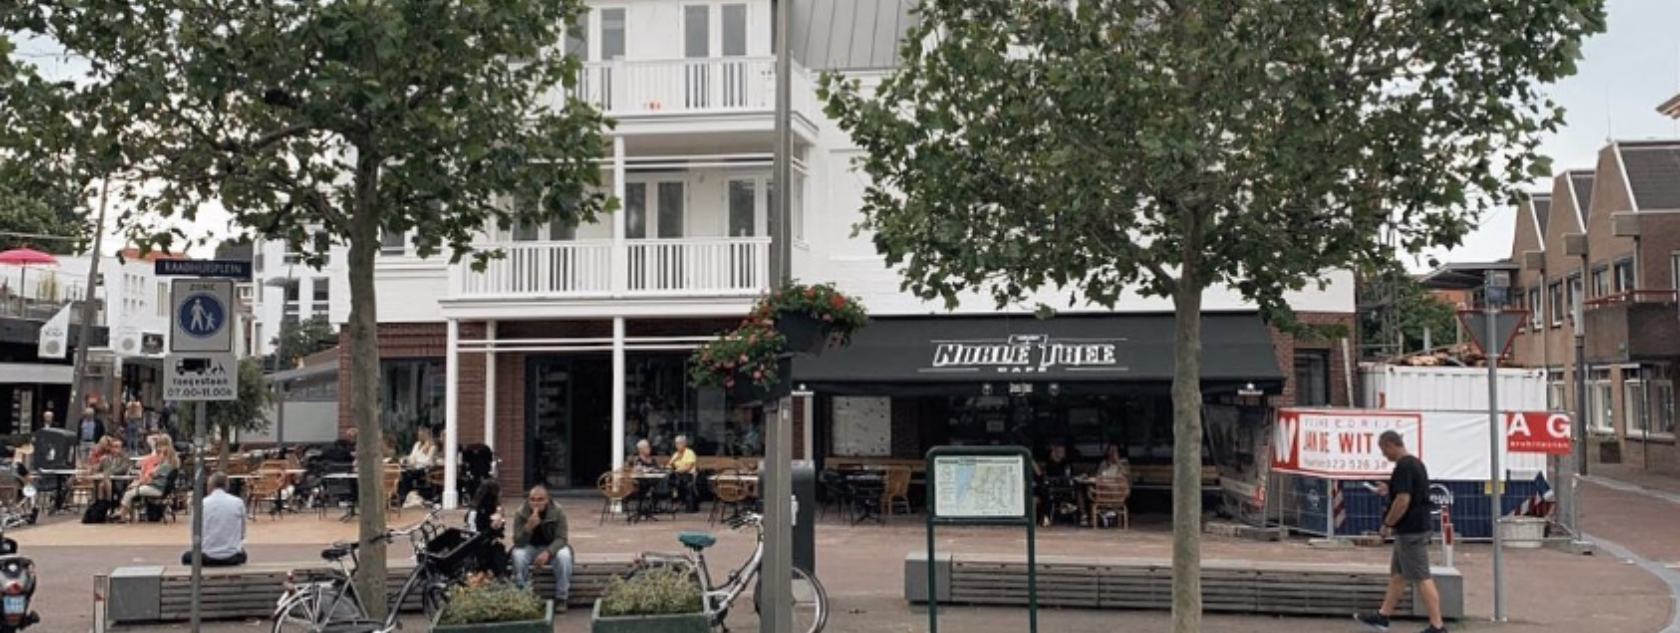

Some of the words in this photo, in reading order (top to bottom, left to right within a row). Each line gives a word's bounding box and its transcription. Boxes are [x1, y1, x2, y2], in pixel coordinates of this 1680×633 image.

[165, 261, 242, 273] RAADHUISPLEIN
[1038, 343, 1116, 367] TREE
[173, 378, 228, 387] toegestaan
[1339, 432, 1374, 454] WIT
